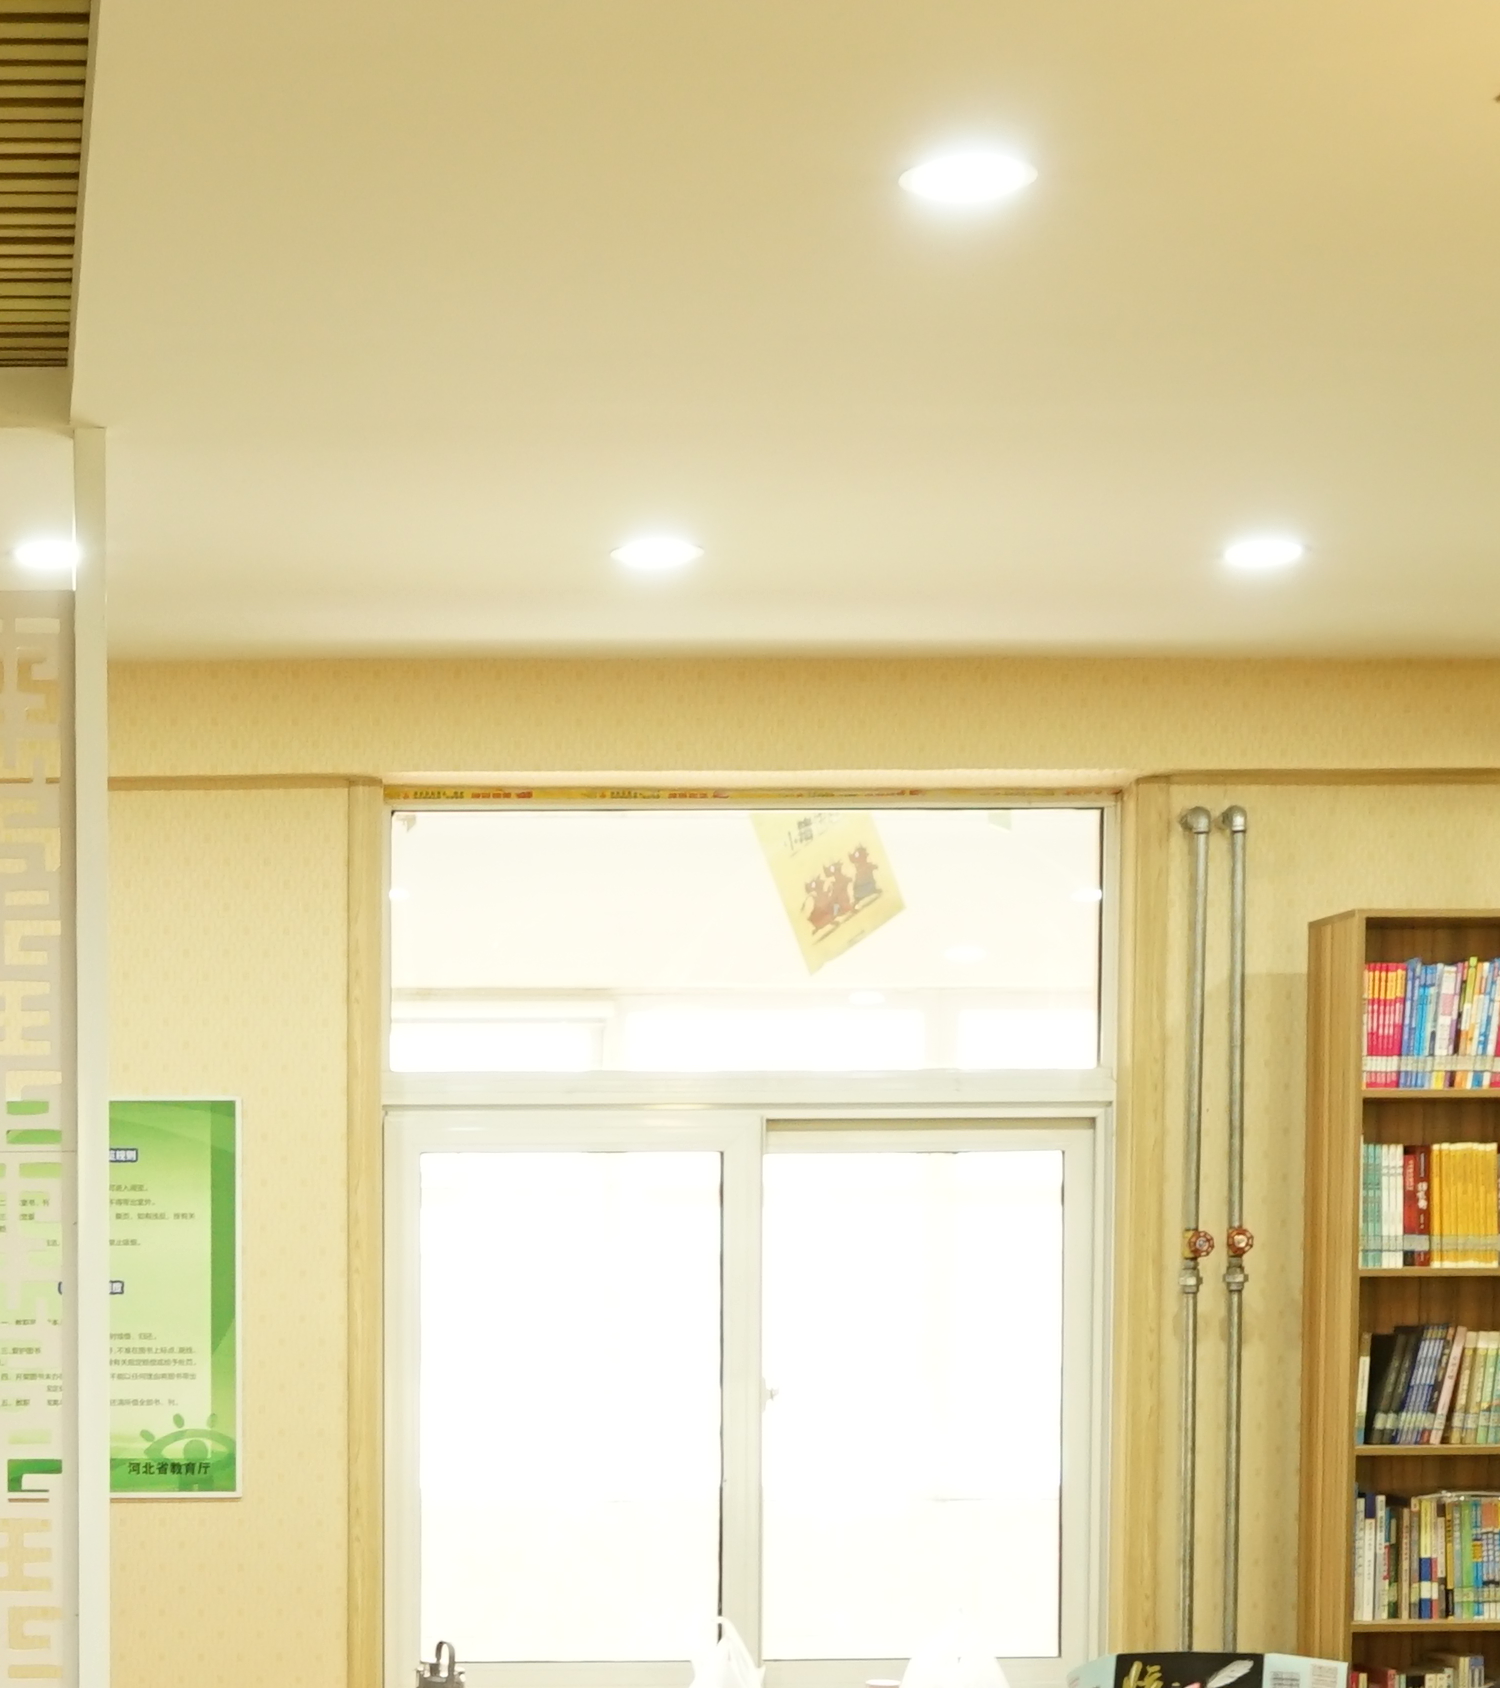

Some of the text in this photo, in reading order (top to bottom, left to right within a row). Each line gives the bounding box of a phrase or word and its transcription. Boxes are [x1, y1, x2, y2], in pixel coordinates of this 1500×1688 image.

[127, 1461, 211, 1476] 河北省教育厅
